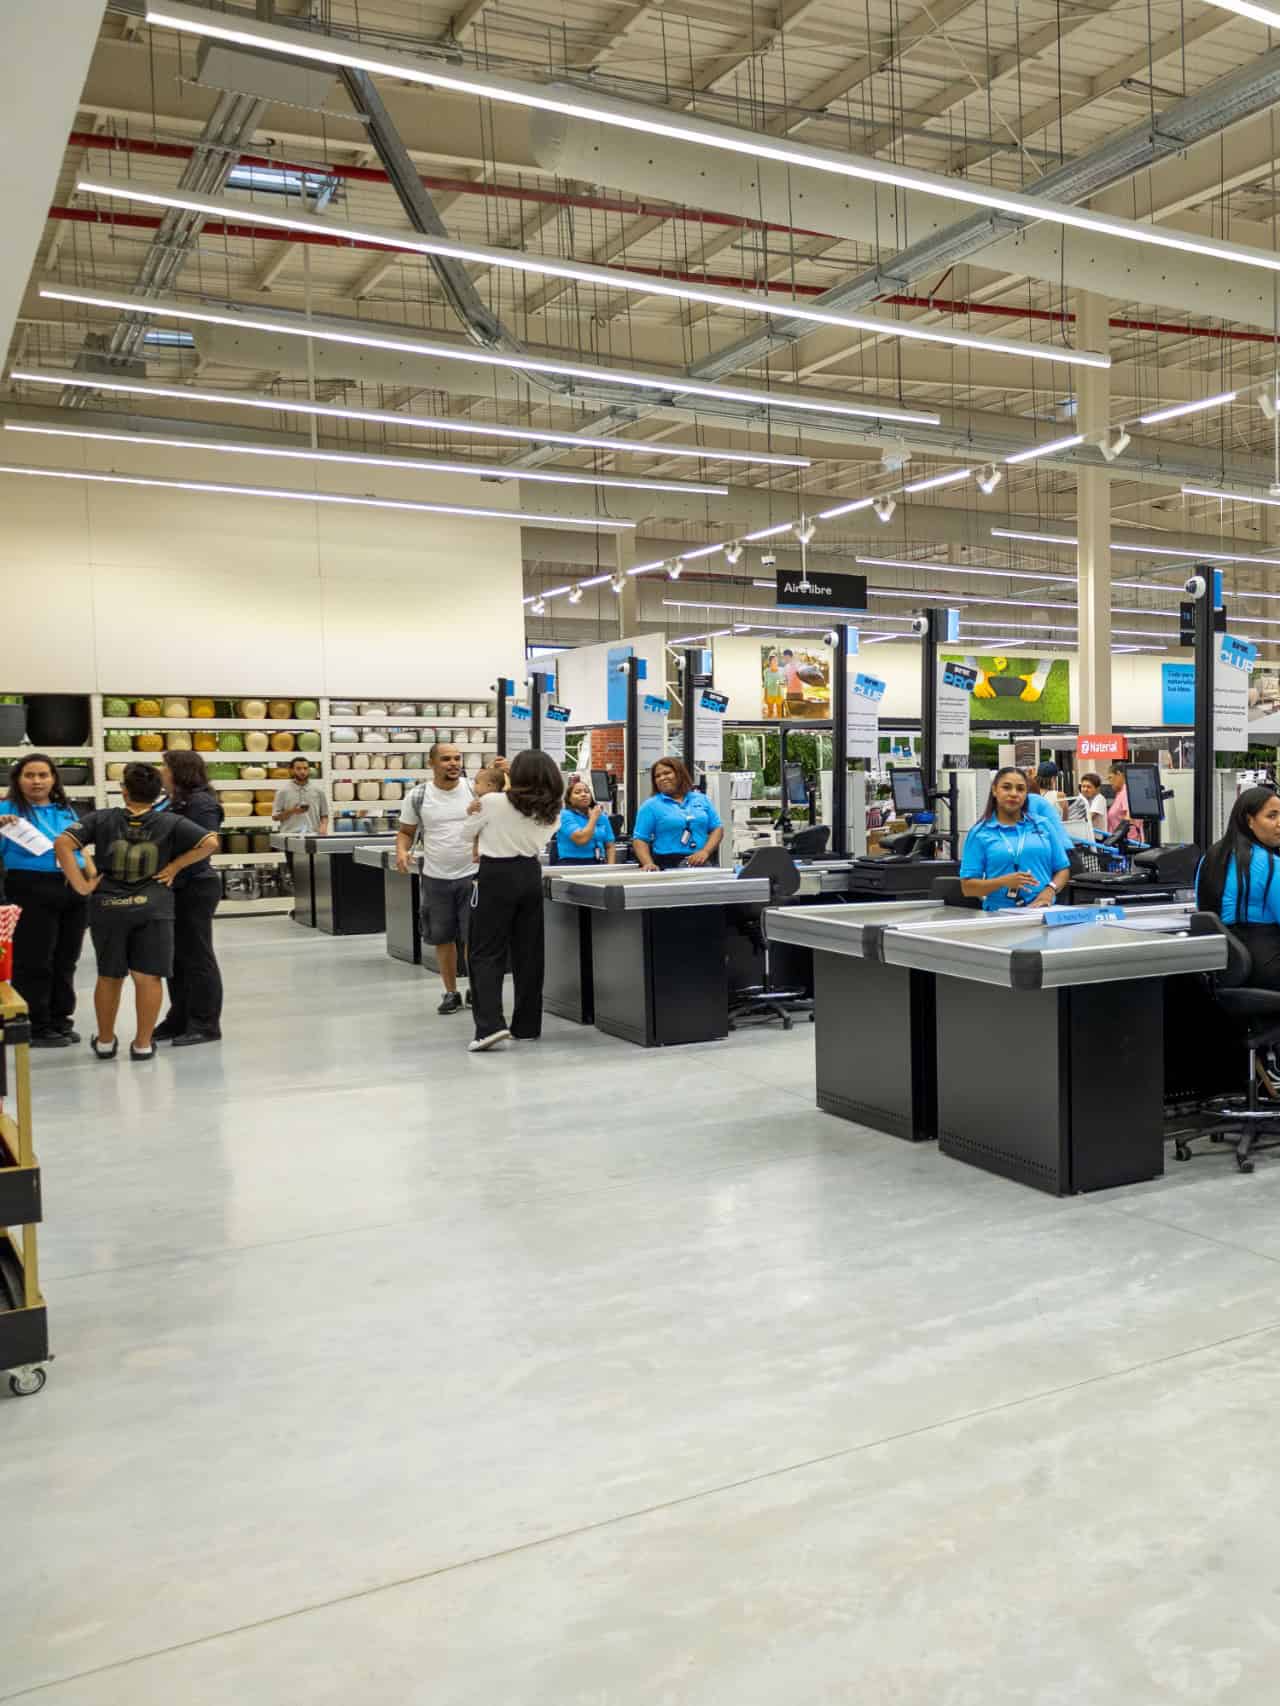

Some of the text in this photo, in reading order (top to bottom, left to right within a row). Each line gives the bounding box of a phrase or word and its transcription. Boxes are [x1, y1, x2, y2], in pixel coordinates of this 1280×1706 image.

[809, 583, 832, 596] libre
[1220, 649, 1254, 674] CLUB
[943, 671, 976, 694] PRO
[701, 697, 726, 713] PRO
[112, 840, 159, 882] 10
[102, 896, 133, 906] unicef
